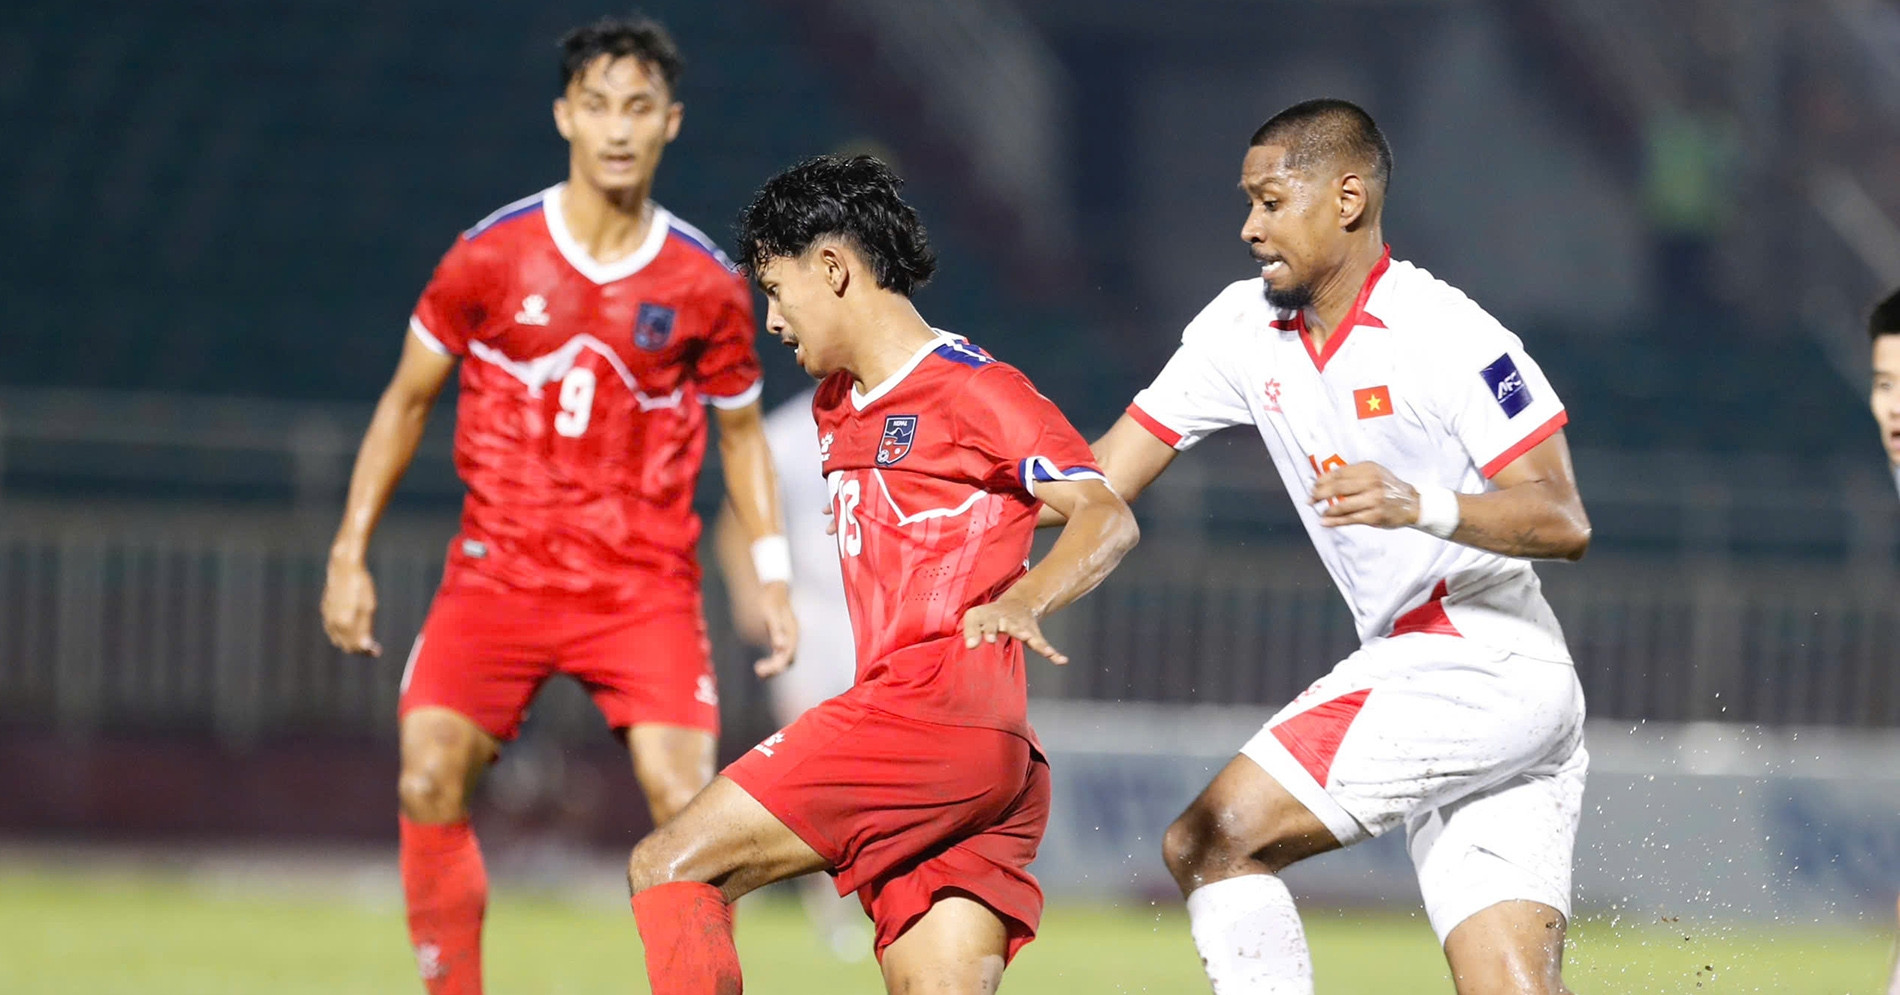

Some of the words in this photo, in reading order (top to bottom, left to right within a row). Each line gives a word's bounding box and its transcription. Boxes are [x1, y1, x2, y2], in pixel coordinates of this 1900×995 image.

[554, 367, 596, 438] 9
[1497, 370, 1522, 400] AFC
[838, 479, 863, 559] 13
